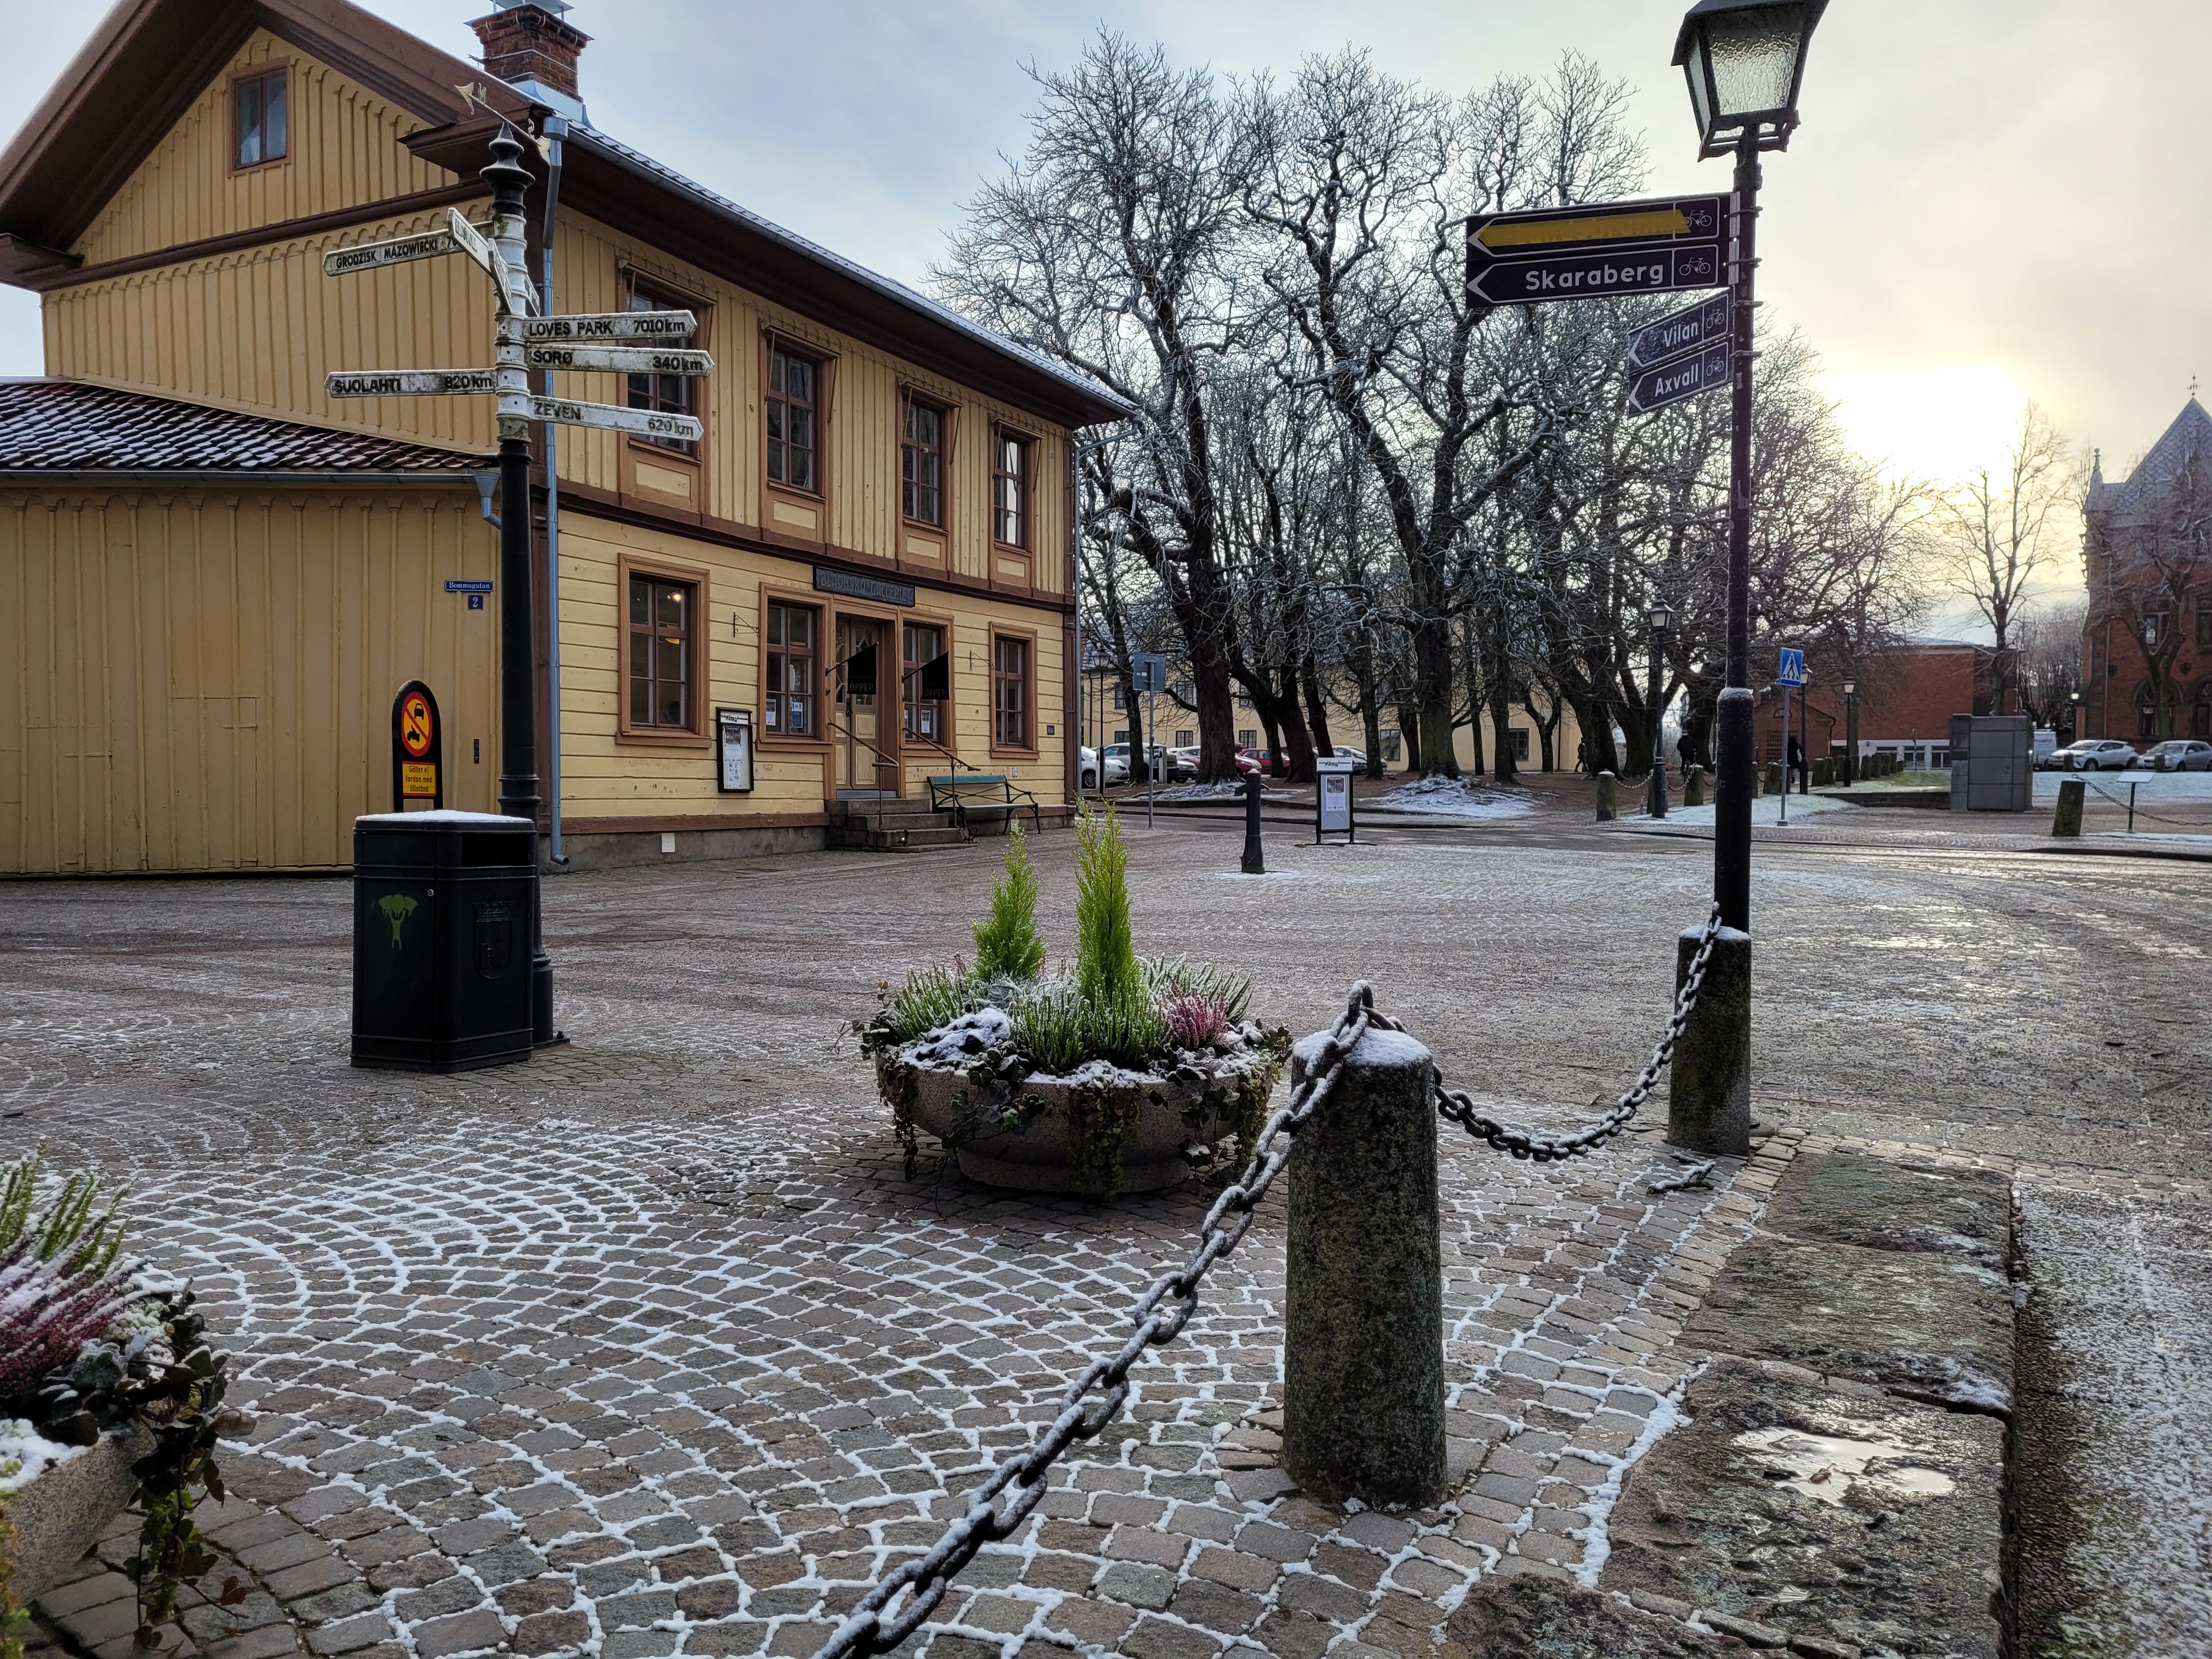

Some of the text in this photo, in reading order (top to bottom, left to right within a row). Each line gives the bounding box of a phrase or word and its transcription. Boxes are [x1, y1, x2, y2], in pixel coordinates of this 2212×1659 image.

[336, 250, 377, 269] GRODZISK
[383, 238, 438, 259] MAZOWIECKI
[1525, 264, 1663, 291] Skaraberg
[529, 321, 569, 336] LOVES
[577, 320, 613, 335] PARK
[1663, 320, 1699, 348] Vilan
[533, 350, 573, 365] SORØ
[334, 378, 402, 394] SUOLAHTI
[1655, 364, 1699, 397] Axvall
[534, 402, 582, 420] ZEVEN
[449, 582, 490, 590] Bommagatan
[821, 571, 913, 602] BLADHSKA GALLERIET
[472, 597, 478, 608] 2
[850, 681, 874, 691] ÖPPET!
[924, 687, 947, 697] ÖPPET!
[424, 766, 429, 775] ej
[406, 775, 421, 783] fordon
